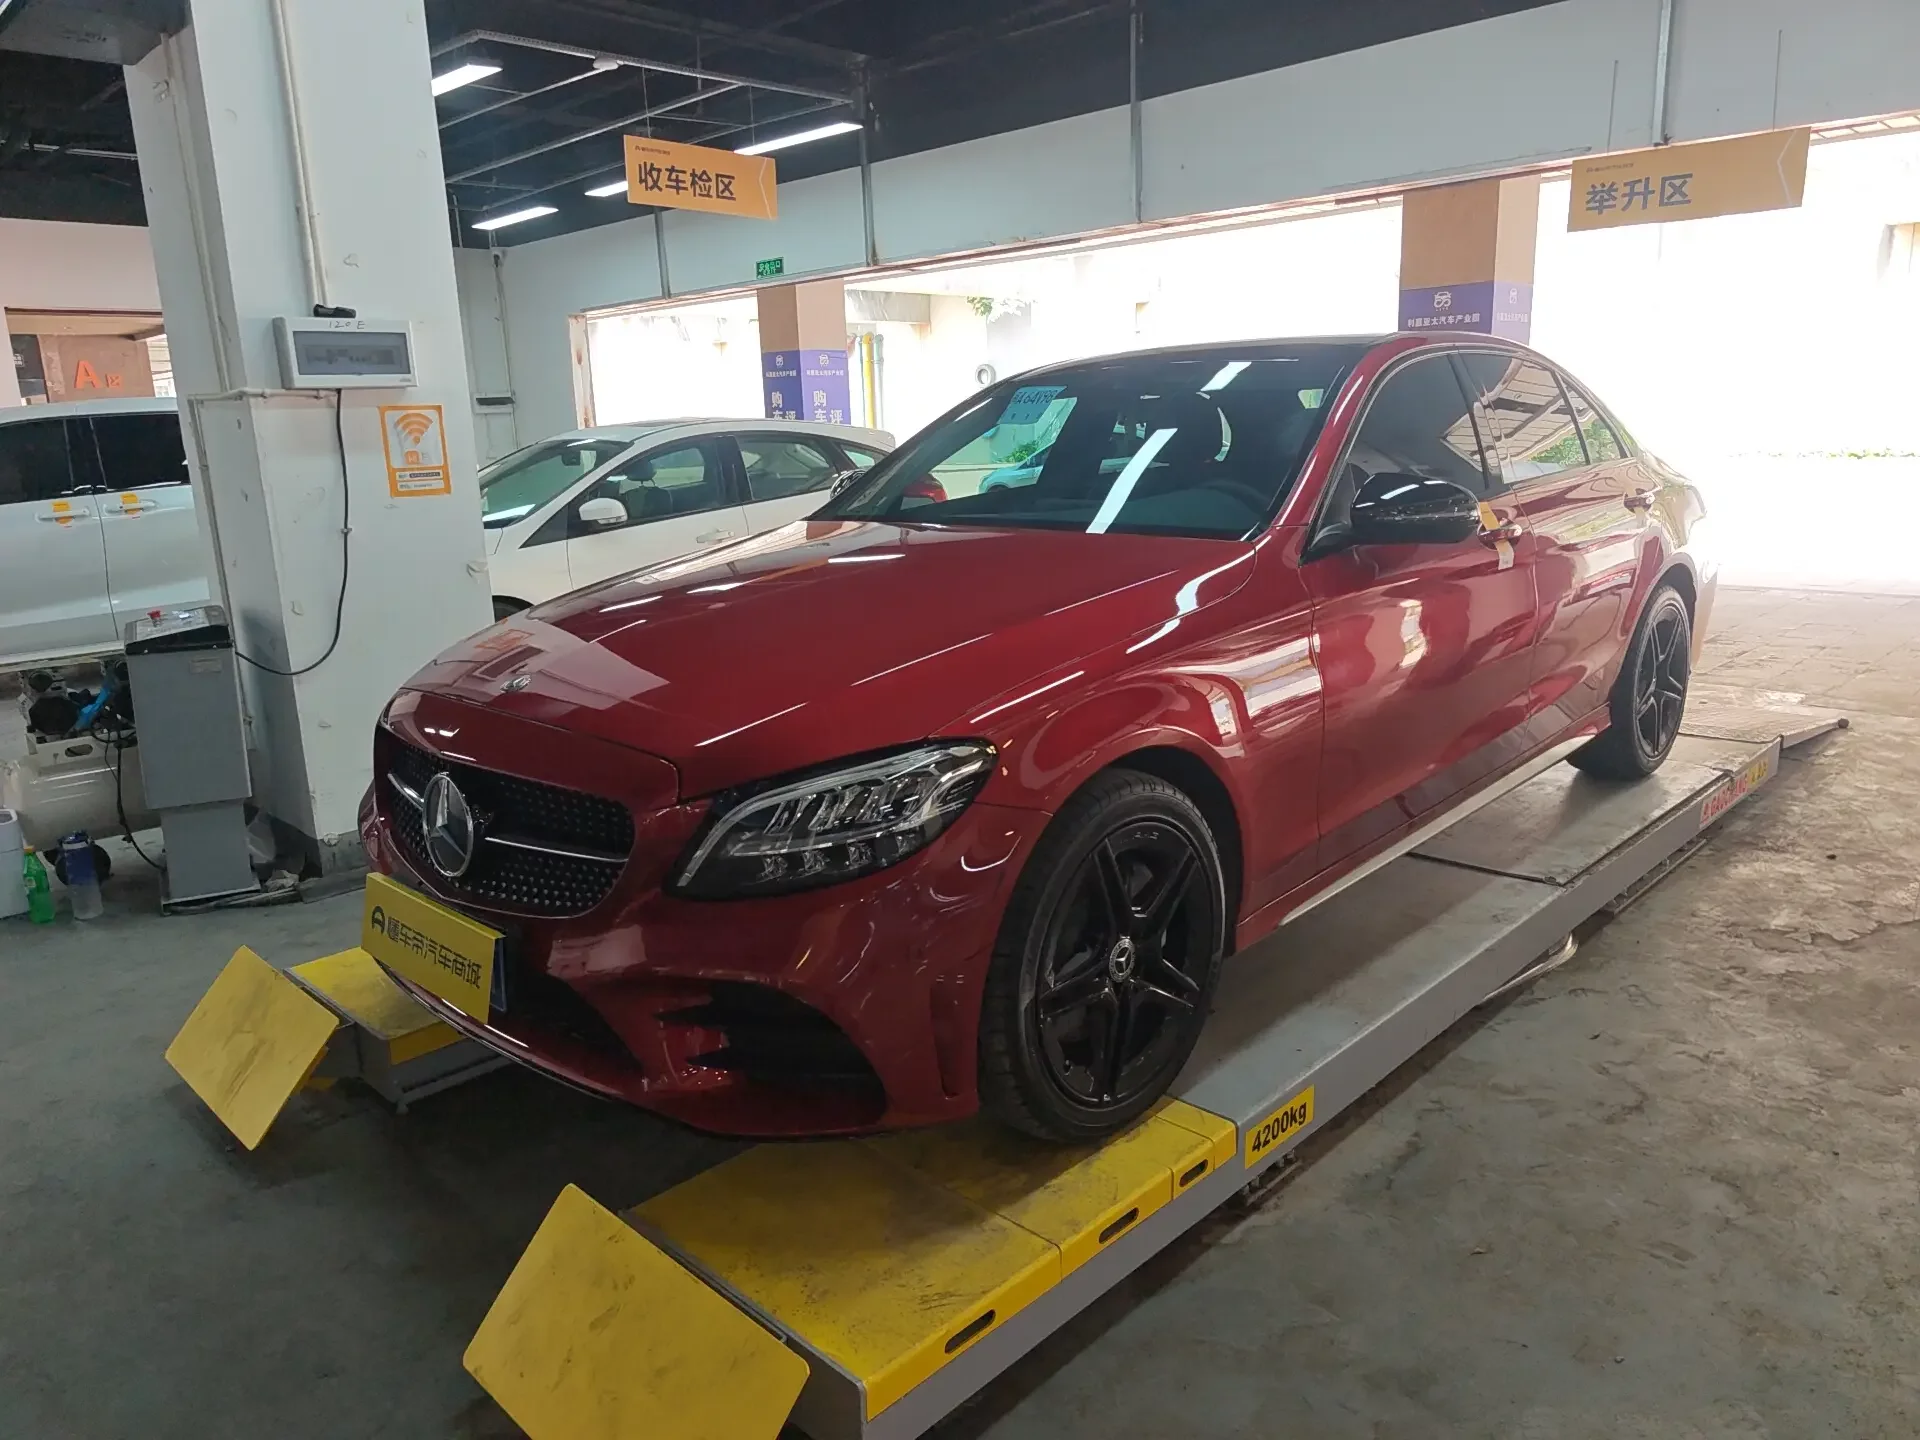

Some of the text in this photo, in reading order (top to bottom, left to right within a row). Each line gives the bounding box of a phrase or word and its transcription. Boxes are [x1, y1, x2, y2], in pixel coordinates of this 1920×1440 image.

[638, 161, 736, 201] 收车检区
[1586, 173, 1693, 216] 举升区
[1251, 1102, 1307, 1153] 4200kg
